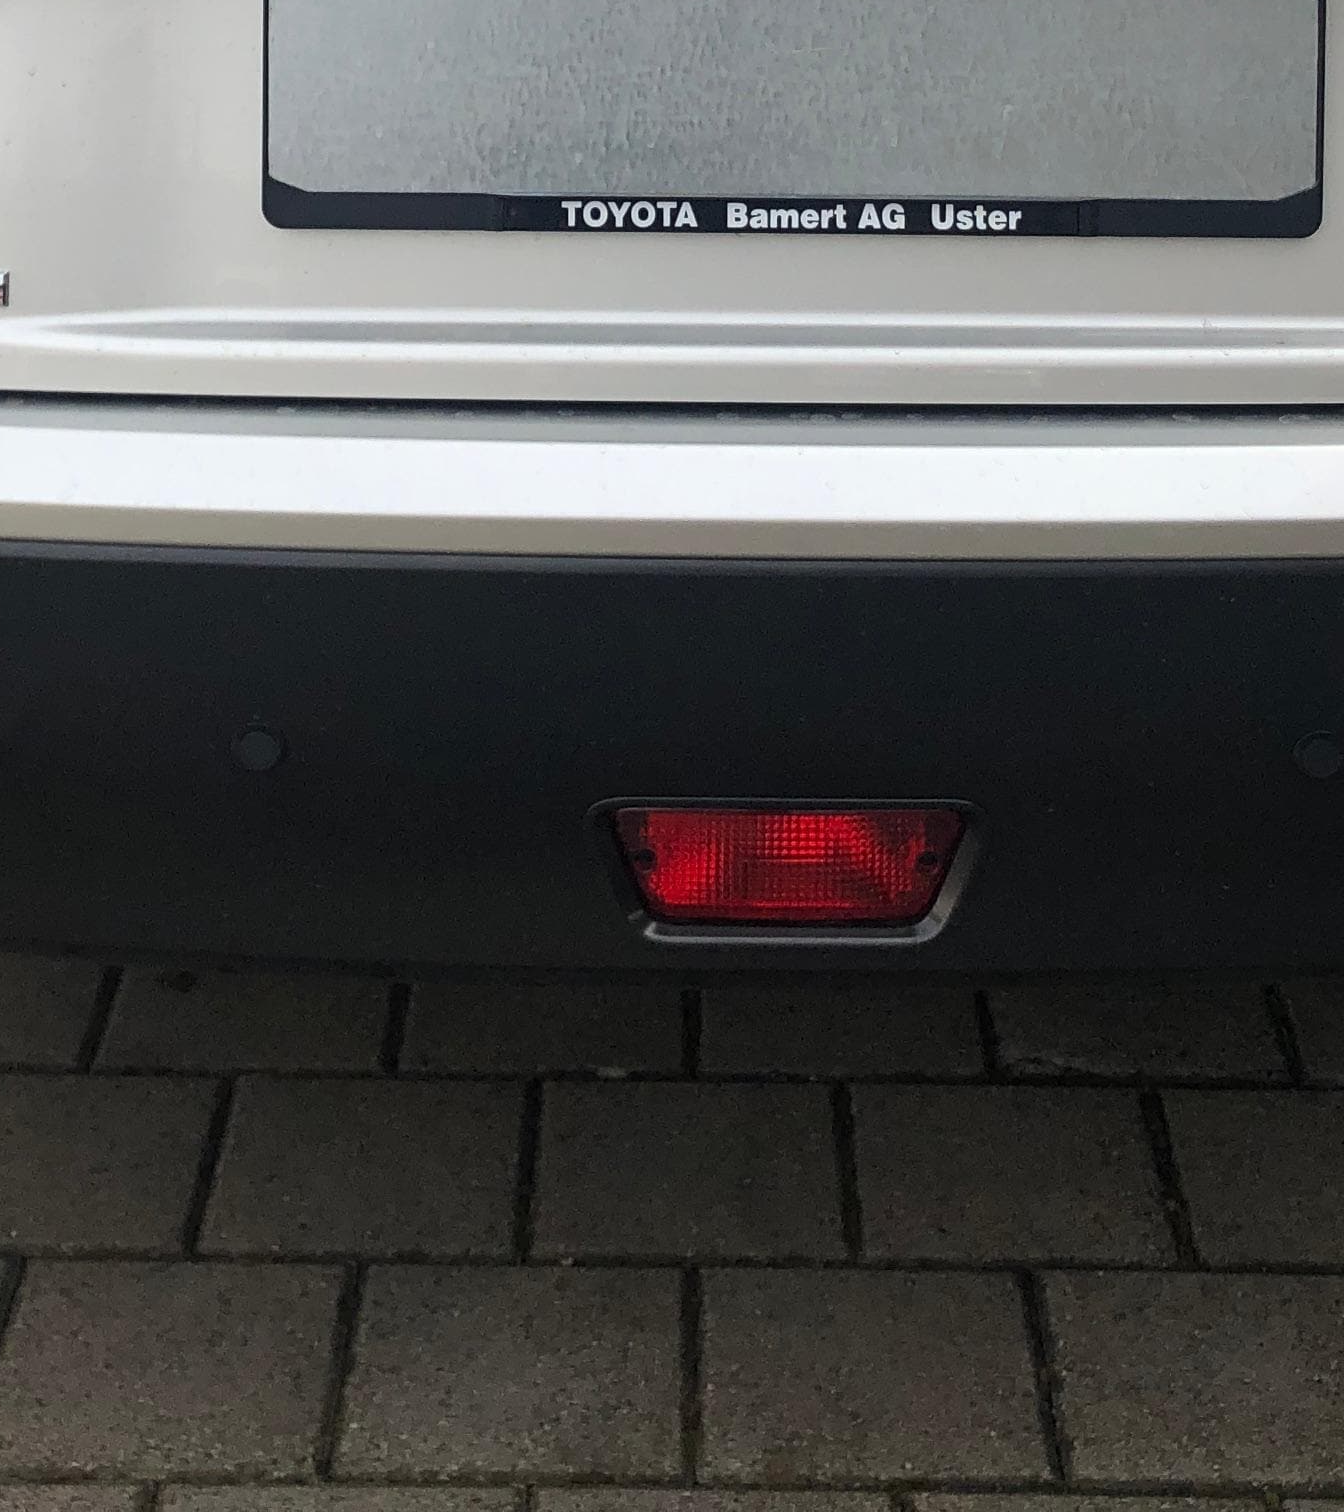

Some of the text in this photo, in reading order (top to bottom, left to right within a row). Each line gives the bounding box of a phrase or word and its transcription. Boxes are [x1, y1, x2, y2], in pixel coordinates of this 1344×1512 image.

[561, 200, 1022, 231] TOYOTA Bamert AG Uster
